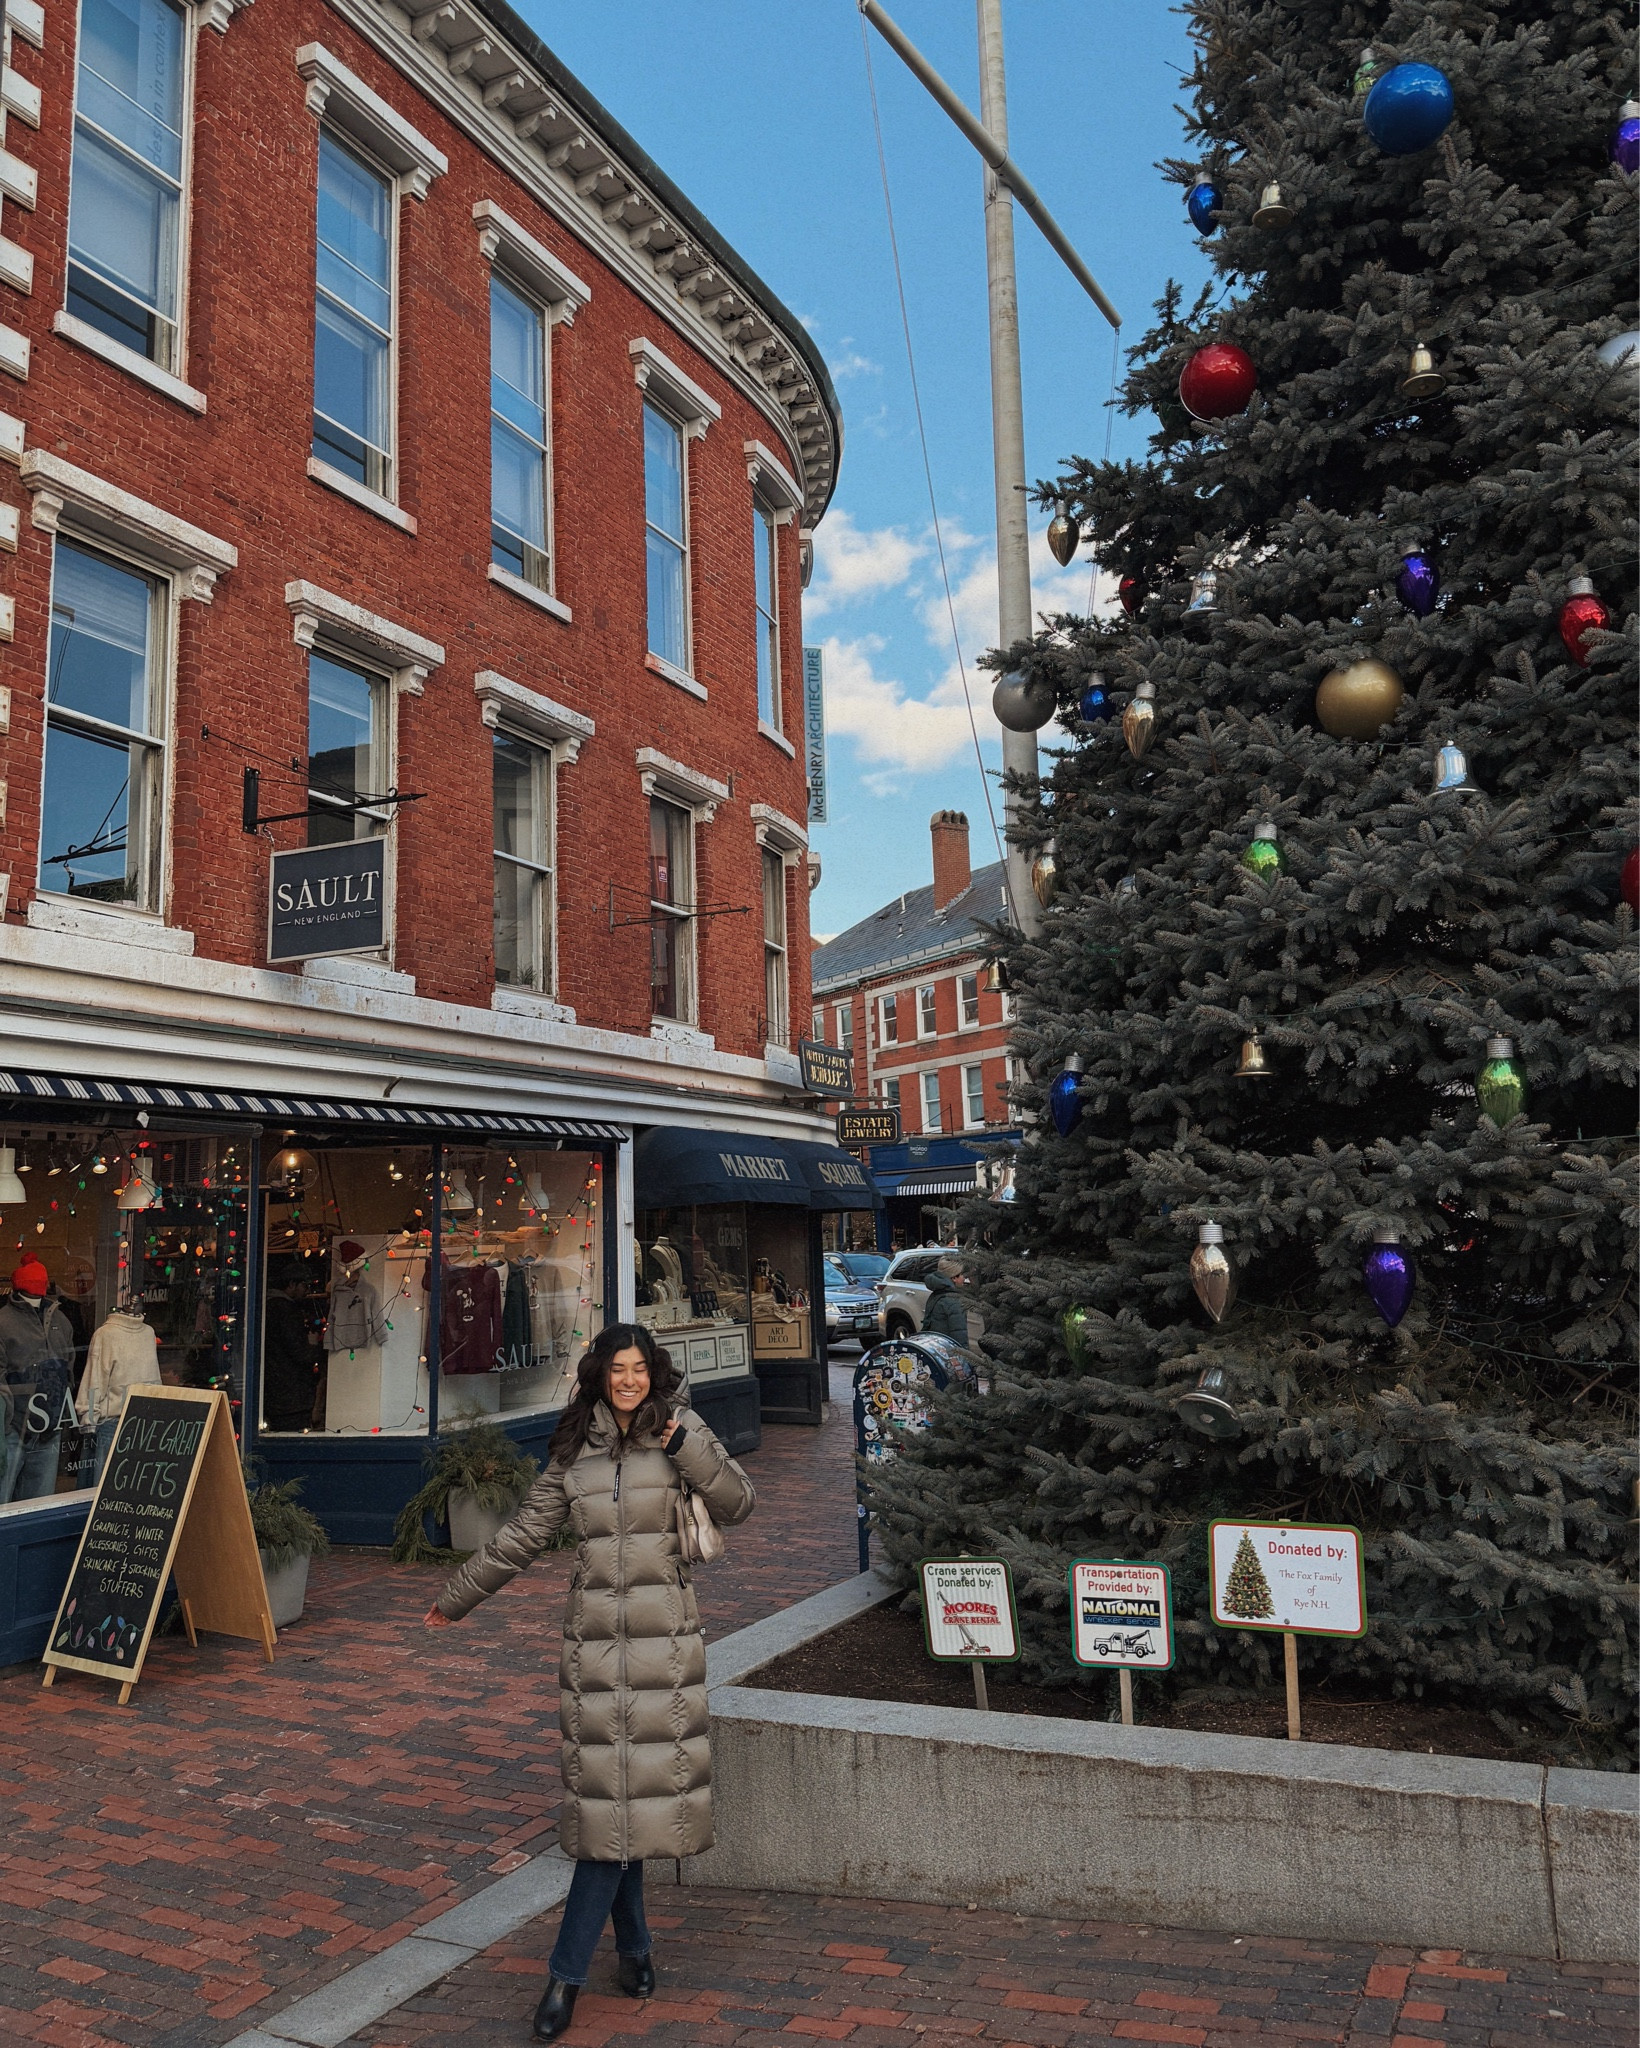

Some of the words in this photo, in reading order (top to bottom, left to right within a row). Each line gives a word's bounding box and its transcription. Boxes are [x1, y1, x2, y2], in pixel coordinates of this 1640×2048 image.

[149, 82, 164, 99] in
[807, 650, 823, 750] ARCHITECTURE
[809, 752, 824, 818] McHENRY
[276, 870, 380, 912] SAULT
[294, 917, 314, 926] NEW
[317, 910, 361, 923] ENGLAND
[845, 1117, 892, 1128] ESTATE
[843, 1128, 893, 1138] JEWELRY
[718, 1153, 791, 1181] MARKET
[818, 1161, 867, 1188] SQUARE
[718, 1227, 743, 1247] GEMS
[770, 1327, 785, 1335] ART
[768, 1335, 789, 1344] DECO
[495, 1340, 556, 1373] SAULT
[116, 1415, 165, 1454] GIVE
[159, 1418, 206, 1456] GREAT
[51, 1440, 79, 1454] NEW
[114, 1458, 178, 1499] GIFTS
[135, 1504, 174, 1520] OUTERWEAR
[135, 1525, 164, 1541] WINTER
[87, 1538, 130, 1555] ACCESSORIES,
[133, 1544, 159, 1562] GIFTS,
[1268, 1541, 1322, 1557] Donated
[1327, 1545, 1348, 1561] by:
[83, 1556, 120, 1573] SKINCARE
[128, 1563, 161, 1579] STOCKING
[927, 1566, 957, 1576] Crane
[960, 1565, 1001, 1576] services
[1080, 1566, 1160, 1580] Transportation
[937, 1577, 976, 1587] Donated
[979, 1578, 994, 1589] by:
[1279, 1569, 1295, 1579] The
[1296, 1571, 1312, 1580] Fox
[1314, 1572, 1343, 1584] Family
[99, 1577, 144, 1599] STUFFERS
[1088, 1581, 1133, 1593] Provided
[1136, 1582, 1153, 1595] by:
[1307, 1585, 1317, 1596] of
[942, 1601, 998, 1616] MOORES
[1083, 1599, 1160, 1617] NATIONAL
[1294, 1599, 1309, 1610] Rye
[1310, 1600, 1330, 1609] N.H.
[943, 1616, 970, 1625] CRANE
[971, 1616, 1001, 1626] RENTAL
[1085, 1616, 1123, 1624] wrecker
[1126, 1618, 1160, 1626] service
